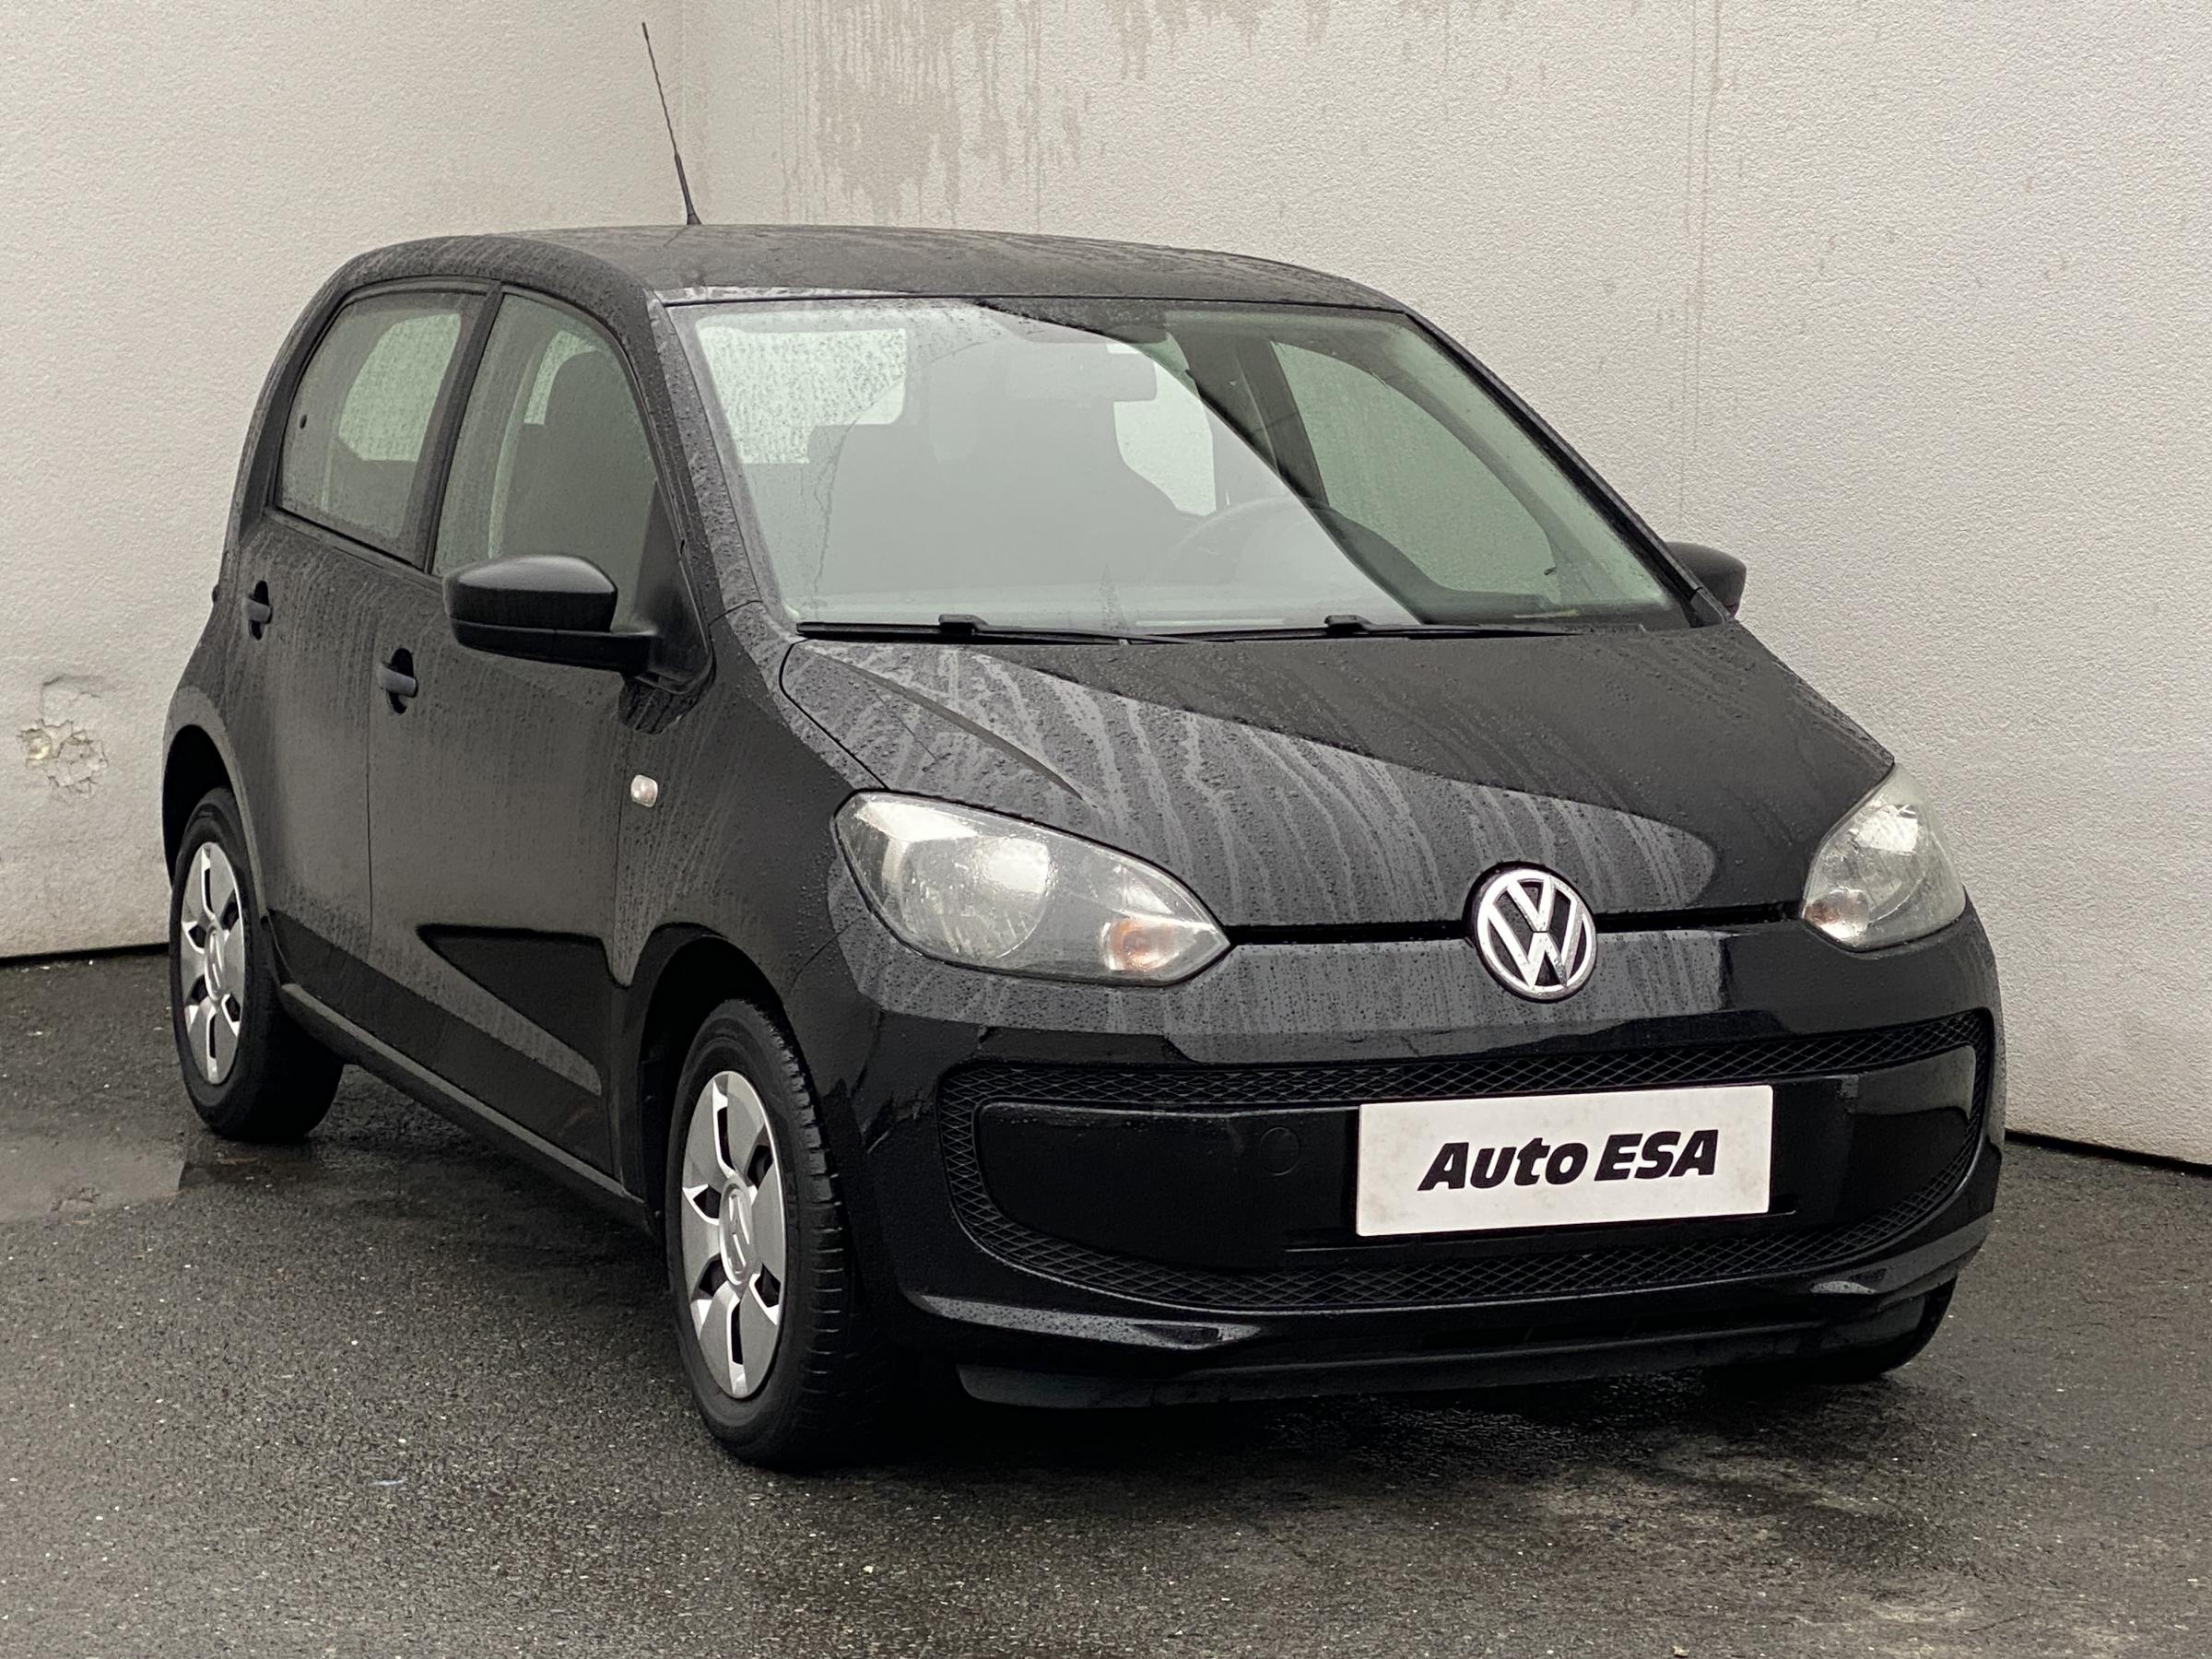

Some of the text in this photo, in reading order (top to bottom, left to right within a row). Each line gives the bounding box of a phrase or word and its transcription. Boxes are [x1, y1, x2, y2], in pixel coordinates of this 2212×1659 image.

[1483, 875, 1591, 994] VW
[1418, 1130, 1719, 1191] Auto ESA
